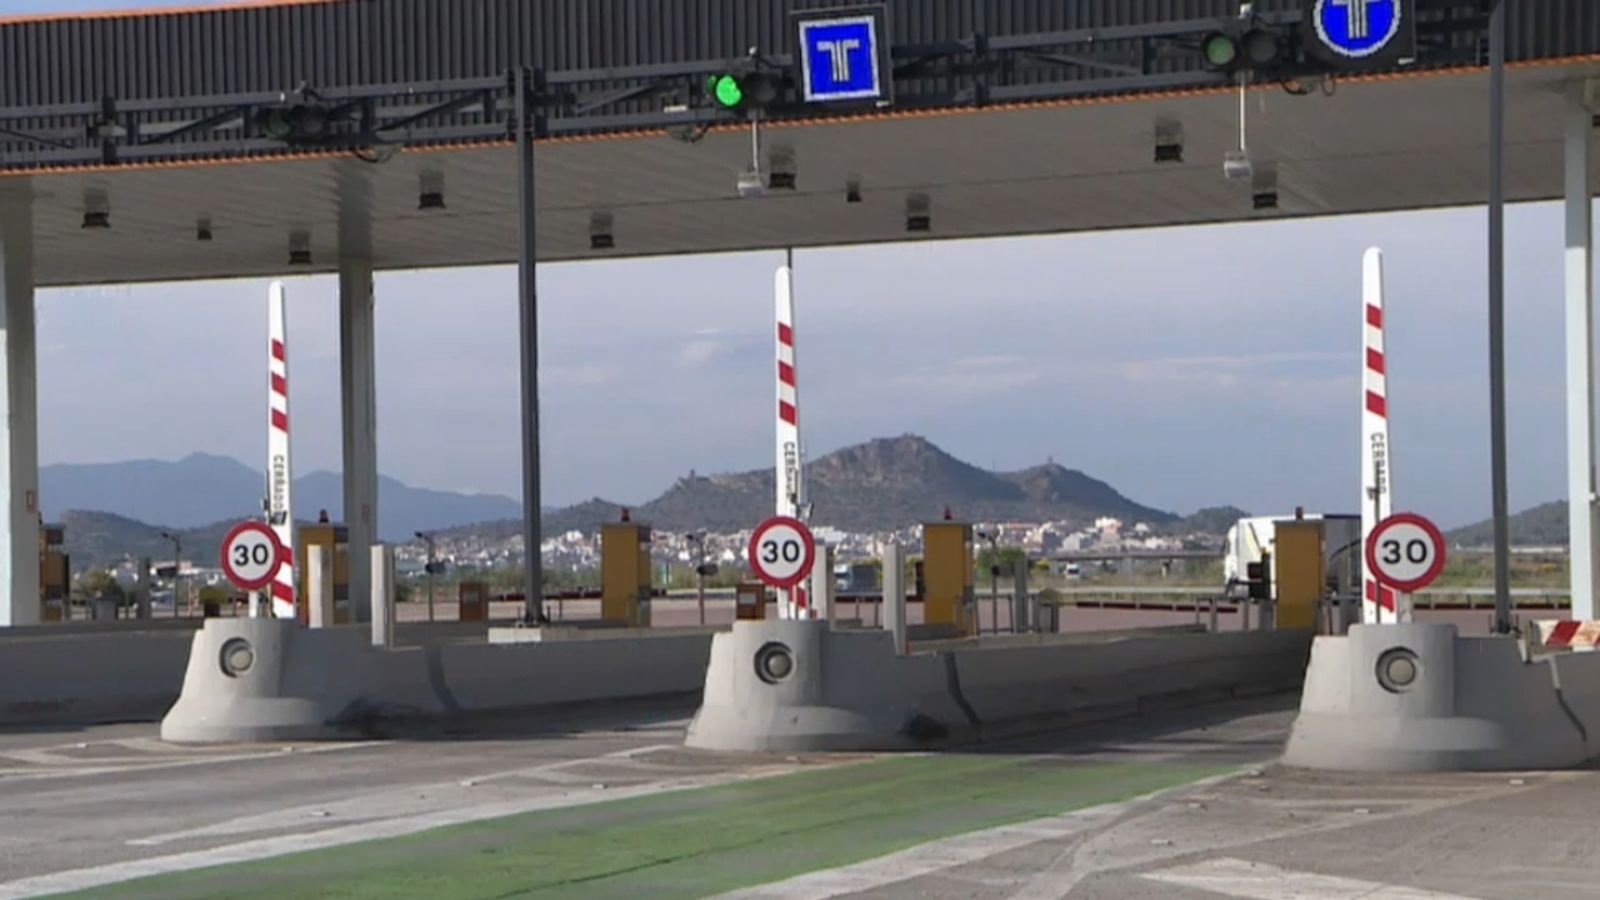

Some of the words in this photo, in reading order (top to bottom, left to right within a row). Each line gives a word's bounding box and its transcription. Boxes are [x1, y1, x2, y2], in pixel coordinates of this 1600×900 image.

[273, 455, 286, 509] CERRADO
[234, 543, 269, 567] 30
[763, 540, 800, 563] 30
[1382, 539, 1427, 565] 30
